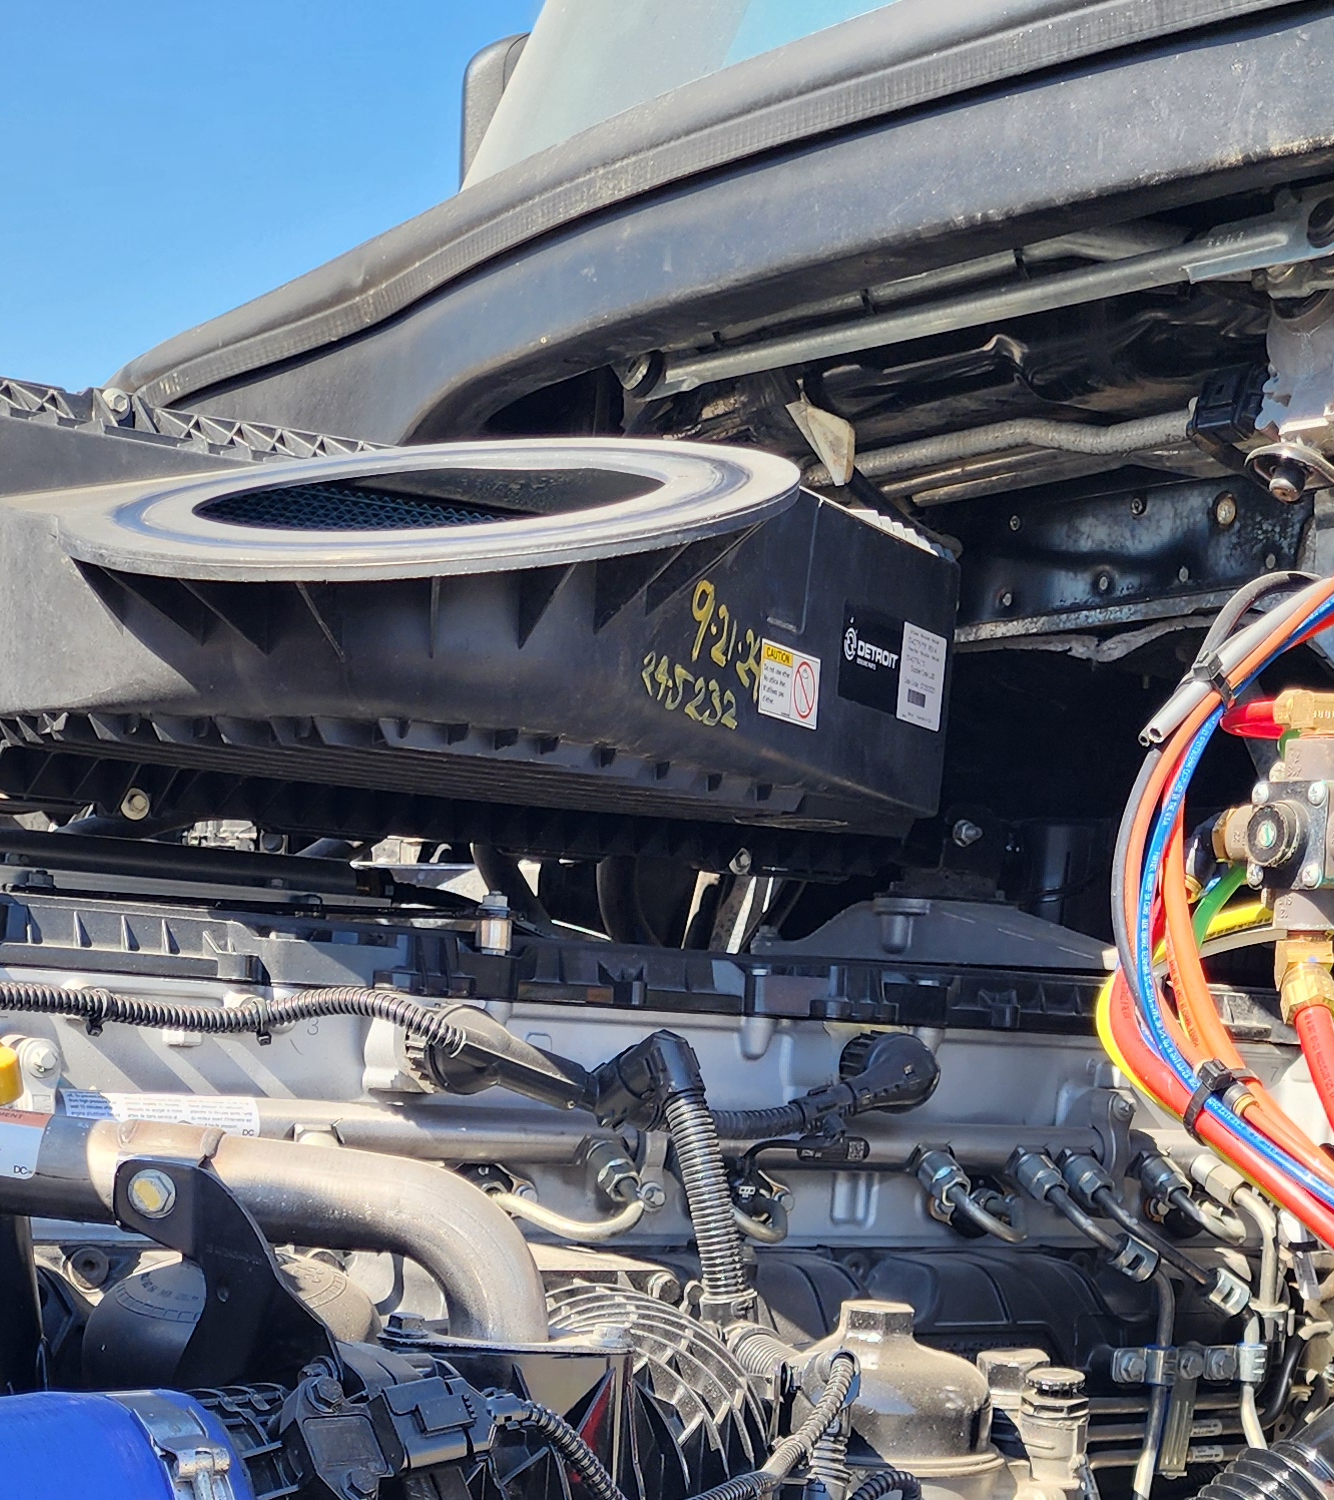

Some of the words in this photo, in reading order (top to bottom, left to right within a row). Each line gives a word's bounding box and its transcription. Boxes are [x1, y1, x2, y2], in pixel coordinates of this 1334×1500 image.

[766, 646, 790, 664] CAUTION
[857, 640, 899, 670] DETROIT
[242, 1128, 255, 1136] DC
[13, 1164, 28, 1175] DC
